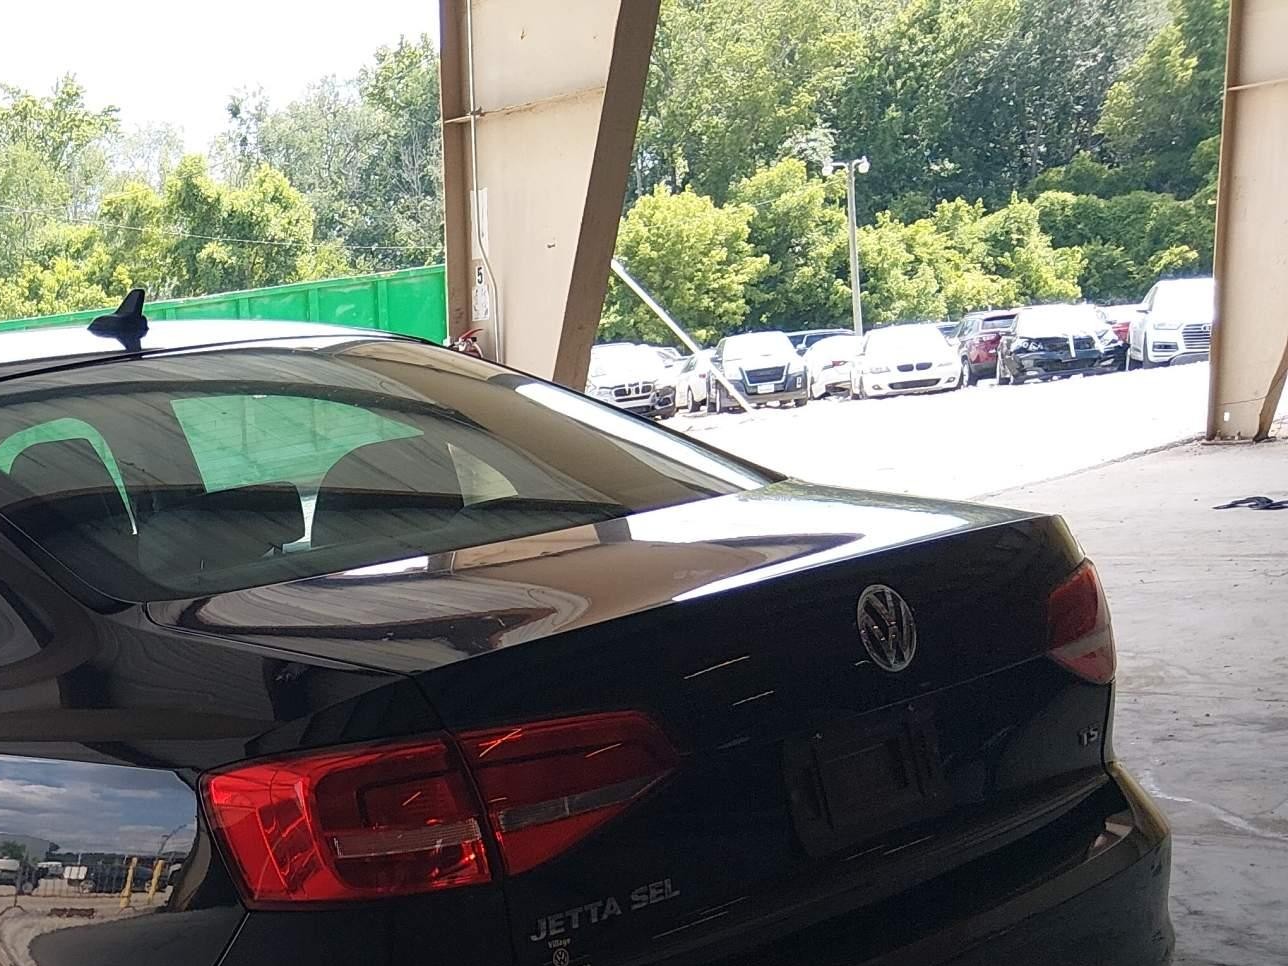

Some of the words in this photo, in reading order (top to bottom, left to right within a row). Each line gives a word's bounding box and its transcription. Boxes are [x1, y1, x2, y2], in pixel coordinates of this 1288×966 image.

[476, 266, 484, 284] 5
[529, 896, 622, 942] JETTA
[630, 878, 681, 911] SEL
